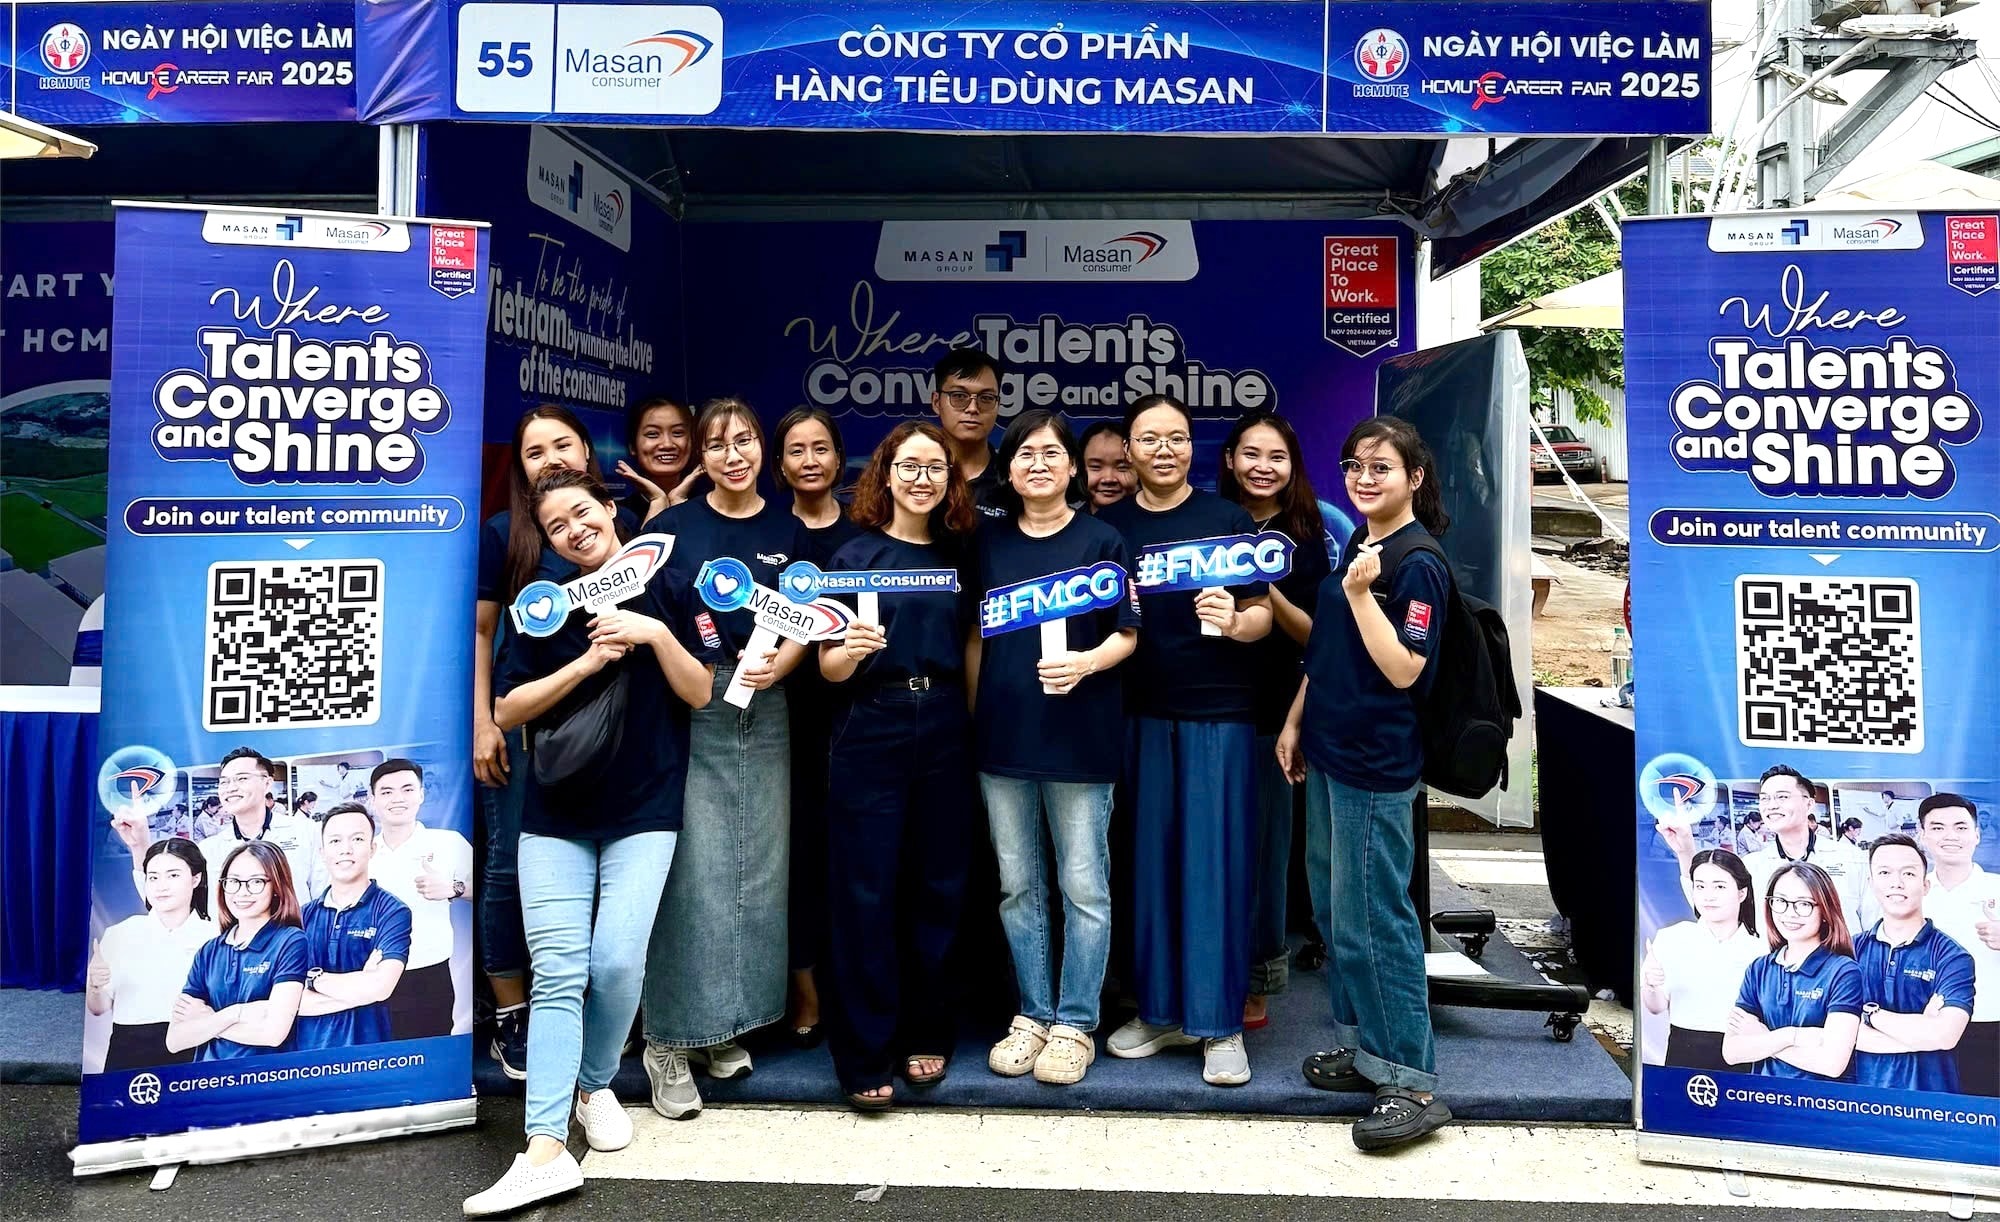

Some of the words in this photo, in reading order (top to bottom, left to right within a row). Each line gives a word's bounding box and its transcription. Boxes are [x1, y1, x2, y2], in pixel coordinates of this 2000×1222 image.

[103, 24, 174, 50] NGÀY
[183, 23, 227, 54] HỘI
[235, 23, 293, 54] VIỆC
[301, 22, 353, 49] LÀM
[838, 24, 946, 59] CÔNG
[958, 32, 1003, 59] TY
[1014, 22, 1068, 60] CỔ
[1081, 22, 1189, 60] PHẦN
[1423, 29, 1502, 58] NGÀY
[1511, 30, 1561, 63] HỘI
[1570, 30, 1634, 64] VIỆC
[1643, 30, 1700, 59] LÀM
[478, 41, 533, 78] 55
[566, 48, 662, 74] Masan
[40, 77, 91, 89] HCMUTE
[237, 71, 273, 85] FAIR
[281, 61, 353, 86] 2025
[592, 76, 661, 88] consumer
[1572, 81, 1612, 96] FAIR
[1621, 72, 1700, 98] 2025
[775, 70, 883, 103] HÀNG
[894, 70, 978, 104] TIÊU
[992, 71, 1101, 105] DÙNG
[1115, 78, 1254, 105] MASAN
[1353, 84, 1409, 97] HCMUTE
[539, 165, 565, 193] MASAN
[222, 225, 268, 234] MASAN
[326, 227, 369, 239] Masan
[434, 228, 465, 238] Great
[1727, 232, 1774, 240] MASAN
[1833, 227, 1879, 240] Masan
[1950, 220, 1985, 230] Great
[1952, 230, 1985, 240] Place
[434, 247, 446, 256] To
[435, 238, 465, 248] Place
[904, 250, 974, 262] MASAN
[1063, 245, 1132, 263] Masan
[1330, 242, 1379, 256] Great
[1952, 241, 1965, 250] To
[435, 270, 471, 279] Certified
[936, 265, 973, 273] GROUP
[1082, 263, 1132, 273] consumer
[1331, 258, 1378, 272] Place
[1954, 266, 1995, 275] Certified
[529, 233, 565, 300] To
[551, 256, 566, 296] be
[567, 257, 586, 303] the
[587, 278, 614, 332] pride
[616, 286, 628, 333] of
[1330, 273, 1349, 287] To
[209, 259, 390, 331] Where
[1720, 264, 1906, 338] Where
[783, 280, 980, 363] Where
[978, 319, 1176, 364] Talents
[1333, 312, 1390, 324] Certified
[202, 331, 422, 383] Talents
[568, 317, 580, 360] by
[580, 325, 615, 370] winning
[616, 336, 629, 367] the
[629, 323, 653, 374] love
[519, 345, 538, 392] of
[538, 348, 562, 396] the
[563, 367, 626, 408] consumers
[1715, 341, 1945, 390] Talents
[808, 363, 1059, 417] Convge
[1061, 381, 1119, 405] and
[1124, 365, 1267, 408] Shine
[159, 374, 442, 433] Converge
[1675, 385, 1970, 444] Converge
[157, 420, 230, 449] and
[233, 422, 416, 473] Shine
[1676, 431, 1748, 459] and
[1751, 432, 1944, 486] Shine
[142, 506, 193, 526] Join
[200, 510, 240, 526] our
[245, 505, 315, 526] talent
[321, 504, 449, 529] community
[1667, 517, 1717, 538] Join
[1723, 520, 1762, 538] our
[1768, 517, 1841, 540] talent
[1846, 521, 1987, 546] community
[1135, 538, 1286, 586] #FMCG
[567, 566, 637, 605] Masan
[814, 574, 866, 588] Masan
[870, 573, 953, 587] Consumer
[592, 581, 641, 607] consumer
[982, 567, 1119, 628] #FMCG
[749, 588, 815, 632] Masan
[762, 614, 809, 640] consumer
[168, 1052, 425, 1094] careers.masanconsumer.com
[1726, 1087, 1997, 1127] careers.masanconsumer.com
